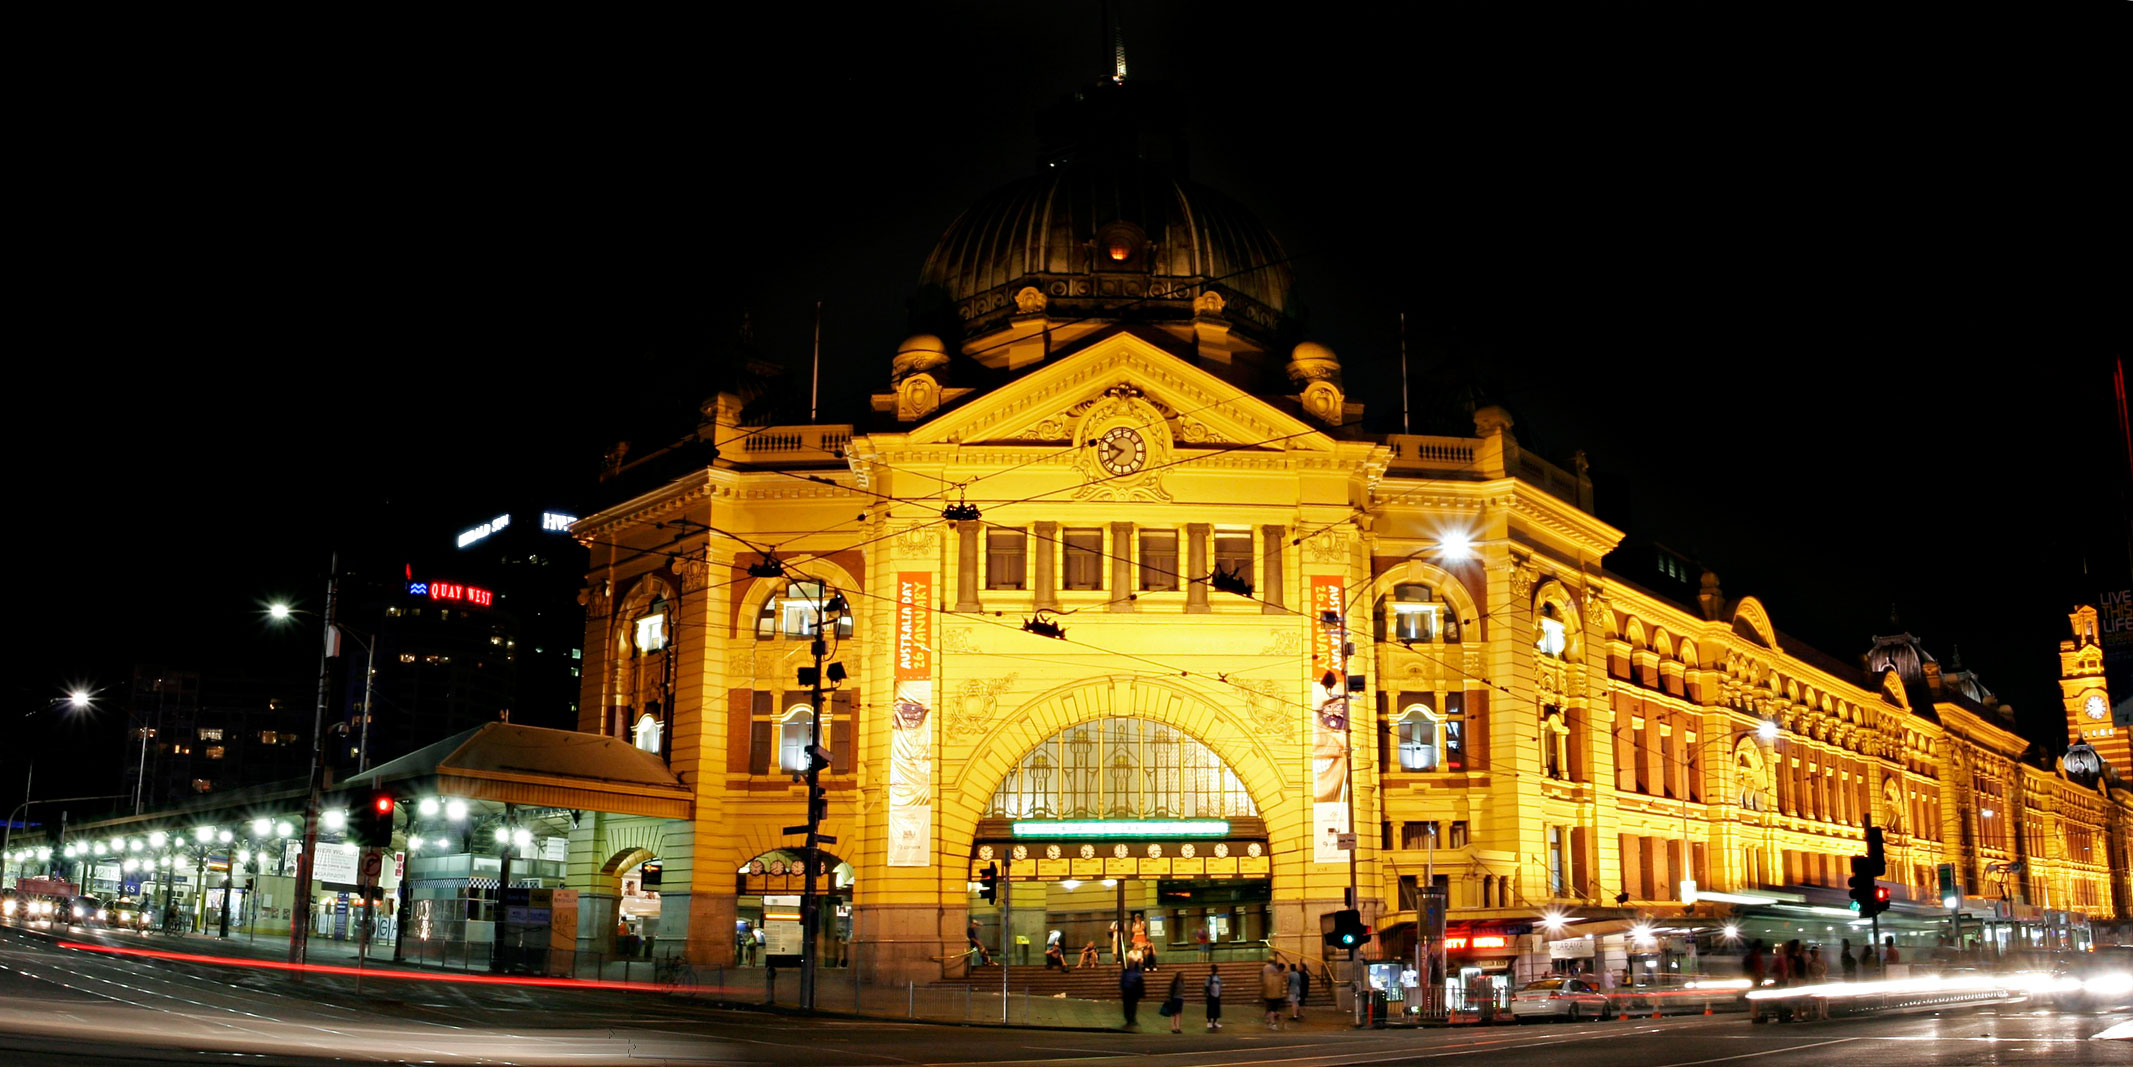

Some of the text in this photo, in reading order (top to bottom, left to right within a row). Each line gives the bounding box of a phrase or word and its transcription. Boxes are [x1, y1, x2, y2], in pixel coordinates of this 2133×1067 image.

[430, 583, 492, 605] QUAY WEST
[1315, 585, 1327, 601] 26
[2100, 589, 2132, 605] LIVE
[900, 582, 912, 669] AUSTRALIA DAY
[913, 582, 927, 668] 26 JANUARY
[2103, 617, 2133, 632] LIFE
